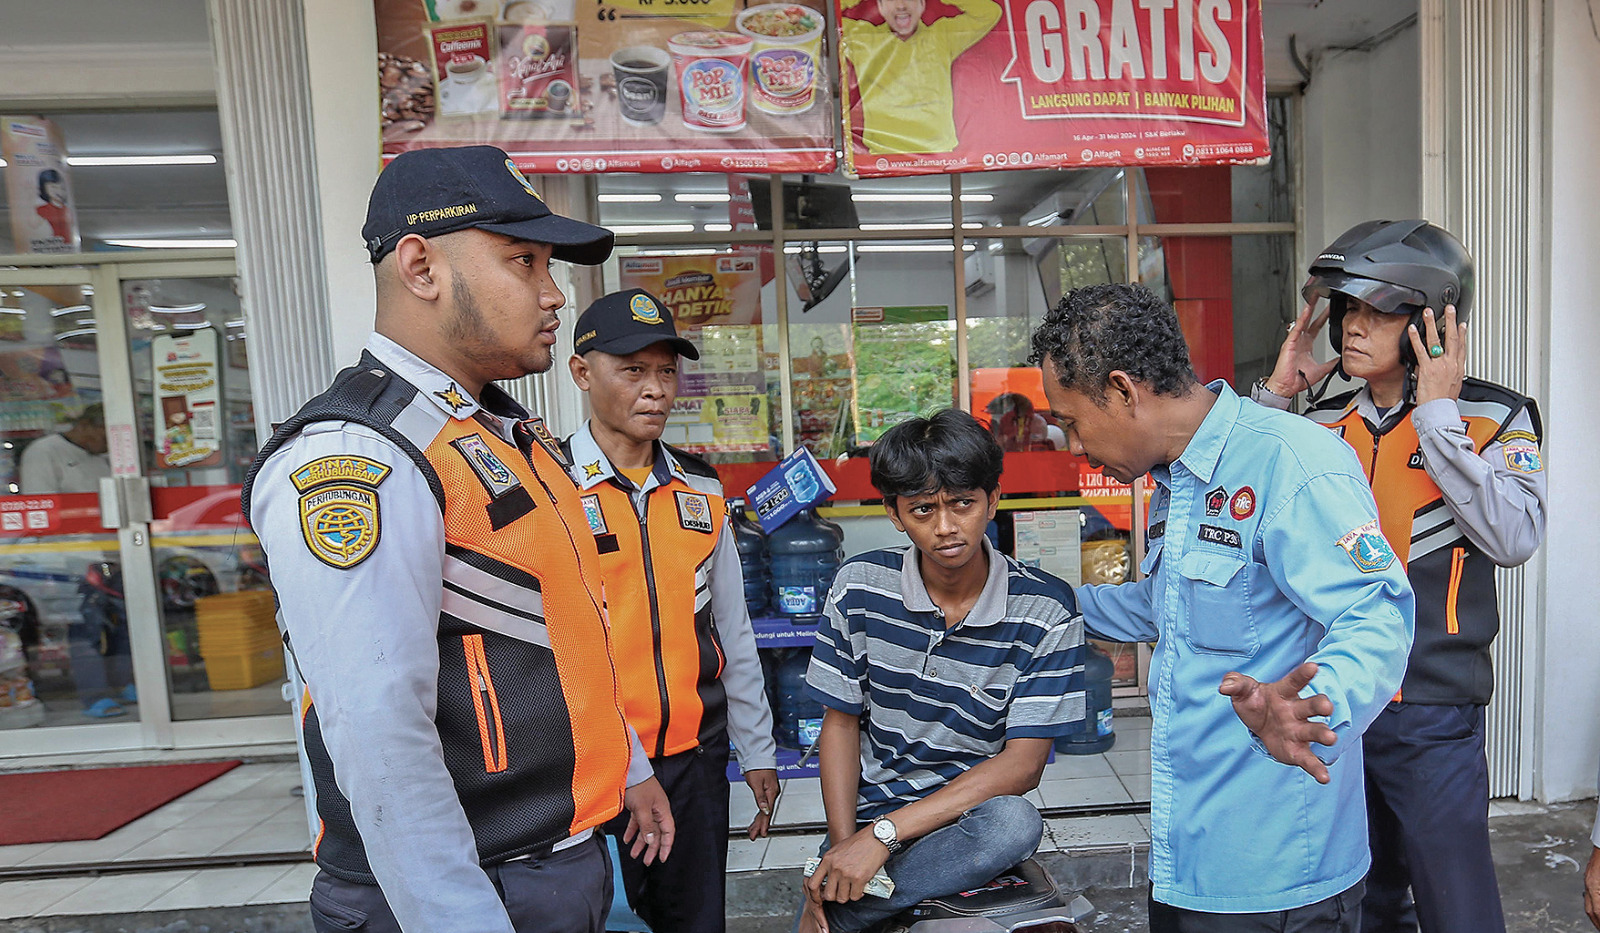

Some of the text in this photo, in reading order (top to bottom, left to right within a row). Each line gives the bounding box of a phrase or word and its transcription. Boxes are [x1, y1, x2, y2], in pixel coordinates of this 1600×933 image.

[1024, 0, 1232, 84] GRATIS
[759, 55, 797, 74] POP
[691, 67, 725, 89] POP
[768, 66, 806, 87] MIE
[699, 79, 734, 101] MIE
[1031, 92, 1130, 110] LANGSUNG DAPAT
[1144, 93, 1235, 113] BANYAK PILIHAN
[1081, 134, 1095, 142] Apr
[1106, 132, 1120, 140] Mei
[890, 152, 1068, 168] www.alfamart.co.id Alfamart
[1093, 149, 1121, 159] Alfagift
[1216, 147, 1234, 155] 1064
[406, 203, 478, 226] UP PERPARKIRAN
[659, 284, 724, 306] HANYA
[678, 300, 734, 318] DETIK
[308, 459, 368, 474] DINAS
[300, 467, 378, 486] PERHUBUNGAN
[307, 490, 372, 510] PERHUBUNGAN
[1235, 496, 1251, 510] TRC
[684, 519, 711, 530] DISHUB
[1203, 527, 1223, 541] TRC
